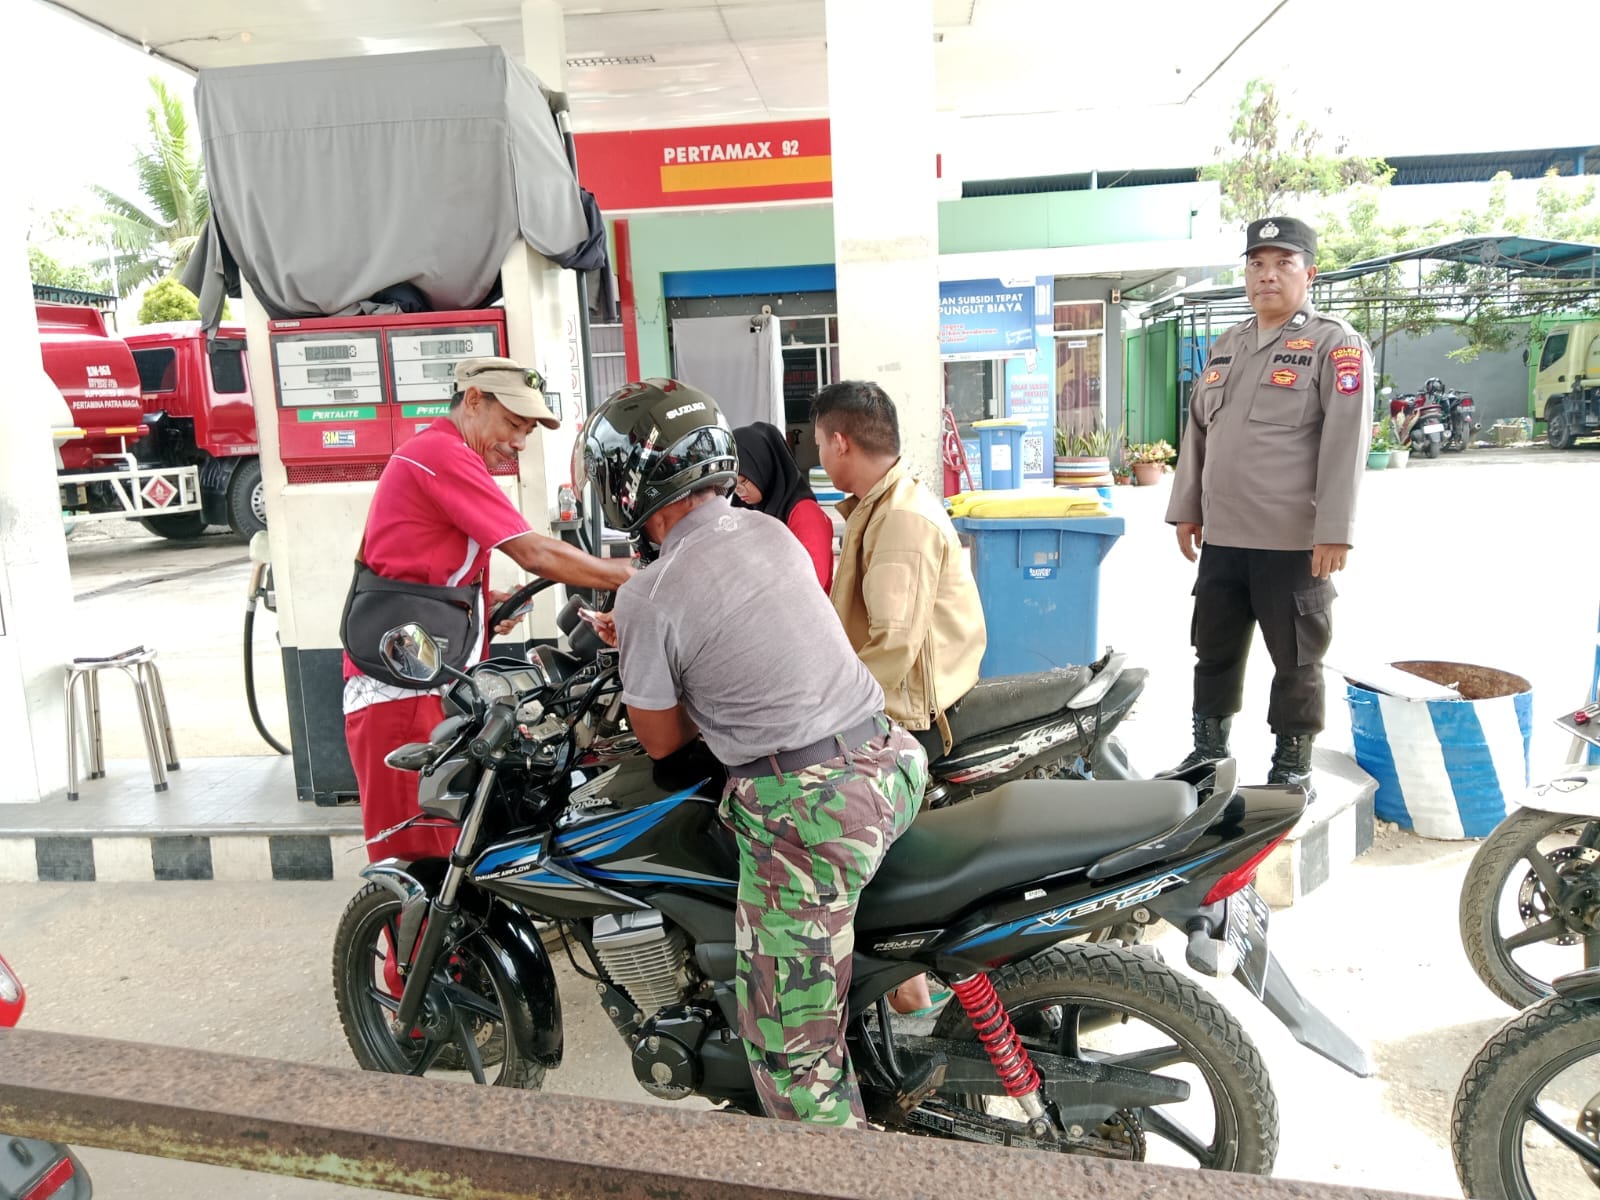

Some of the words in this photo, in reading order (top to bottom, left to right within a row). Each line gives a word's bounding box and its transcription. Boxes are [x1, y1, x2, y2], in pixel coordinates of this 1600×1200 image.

[664, 141, 772, 164] PERTAMAX
[782, 140, 799, 156] 92
[939, 297, 956, 305] AN
[958, 295, 994, 305] SUBSIDI
[995, 293, 1024, 302] TEPAT
[987, 302, 1023, 313] BIAYA
[1273, 353, 1313, 367] POLRI
[73, 400, 104, 409] PERTAMINA
[416, 406, 451, 415] PERTAL
[666, 401, 706, 420] SUZUKI
[312, 410, 360, 420] PERTALITE
[324, 431, 339, 445] 3M
[563, 797, 613, 815] HONDA
[474, 871, 501, 882] DYNAMIC
[501, 863, 531, 877] AIRFLOW
[1037, 873, 1190, 928] VERZA
[873, 939, 926, 950] PGM-FI
